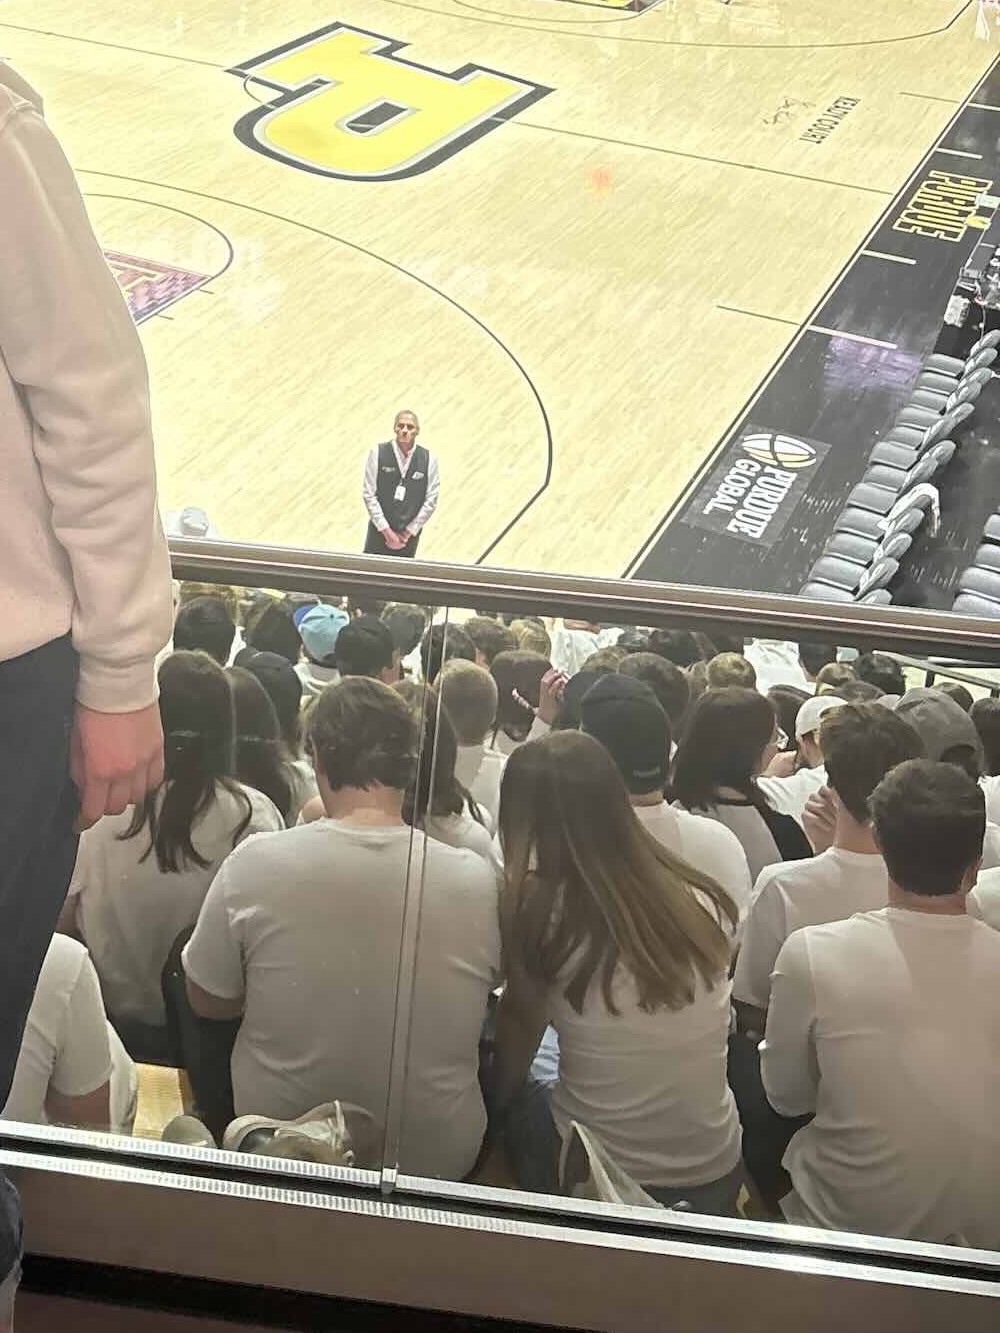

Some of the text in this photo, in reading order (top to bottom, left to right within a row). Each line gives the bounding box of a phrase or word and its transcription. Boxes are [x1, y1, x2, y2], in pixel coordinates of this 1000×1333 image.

[892, 170, 994, 243] PURDUE
[702, 458, 762, 515] GLOBAL
[726, 465, 798, 539] PURDUE
